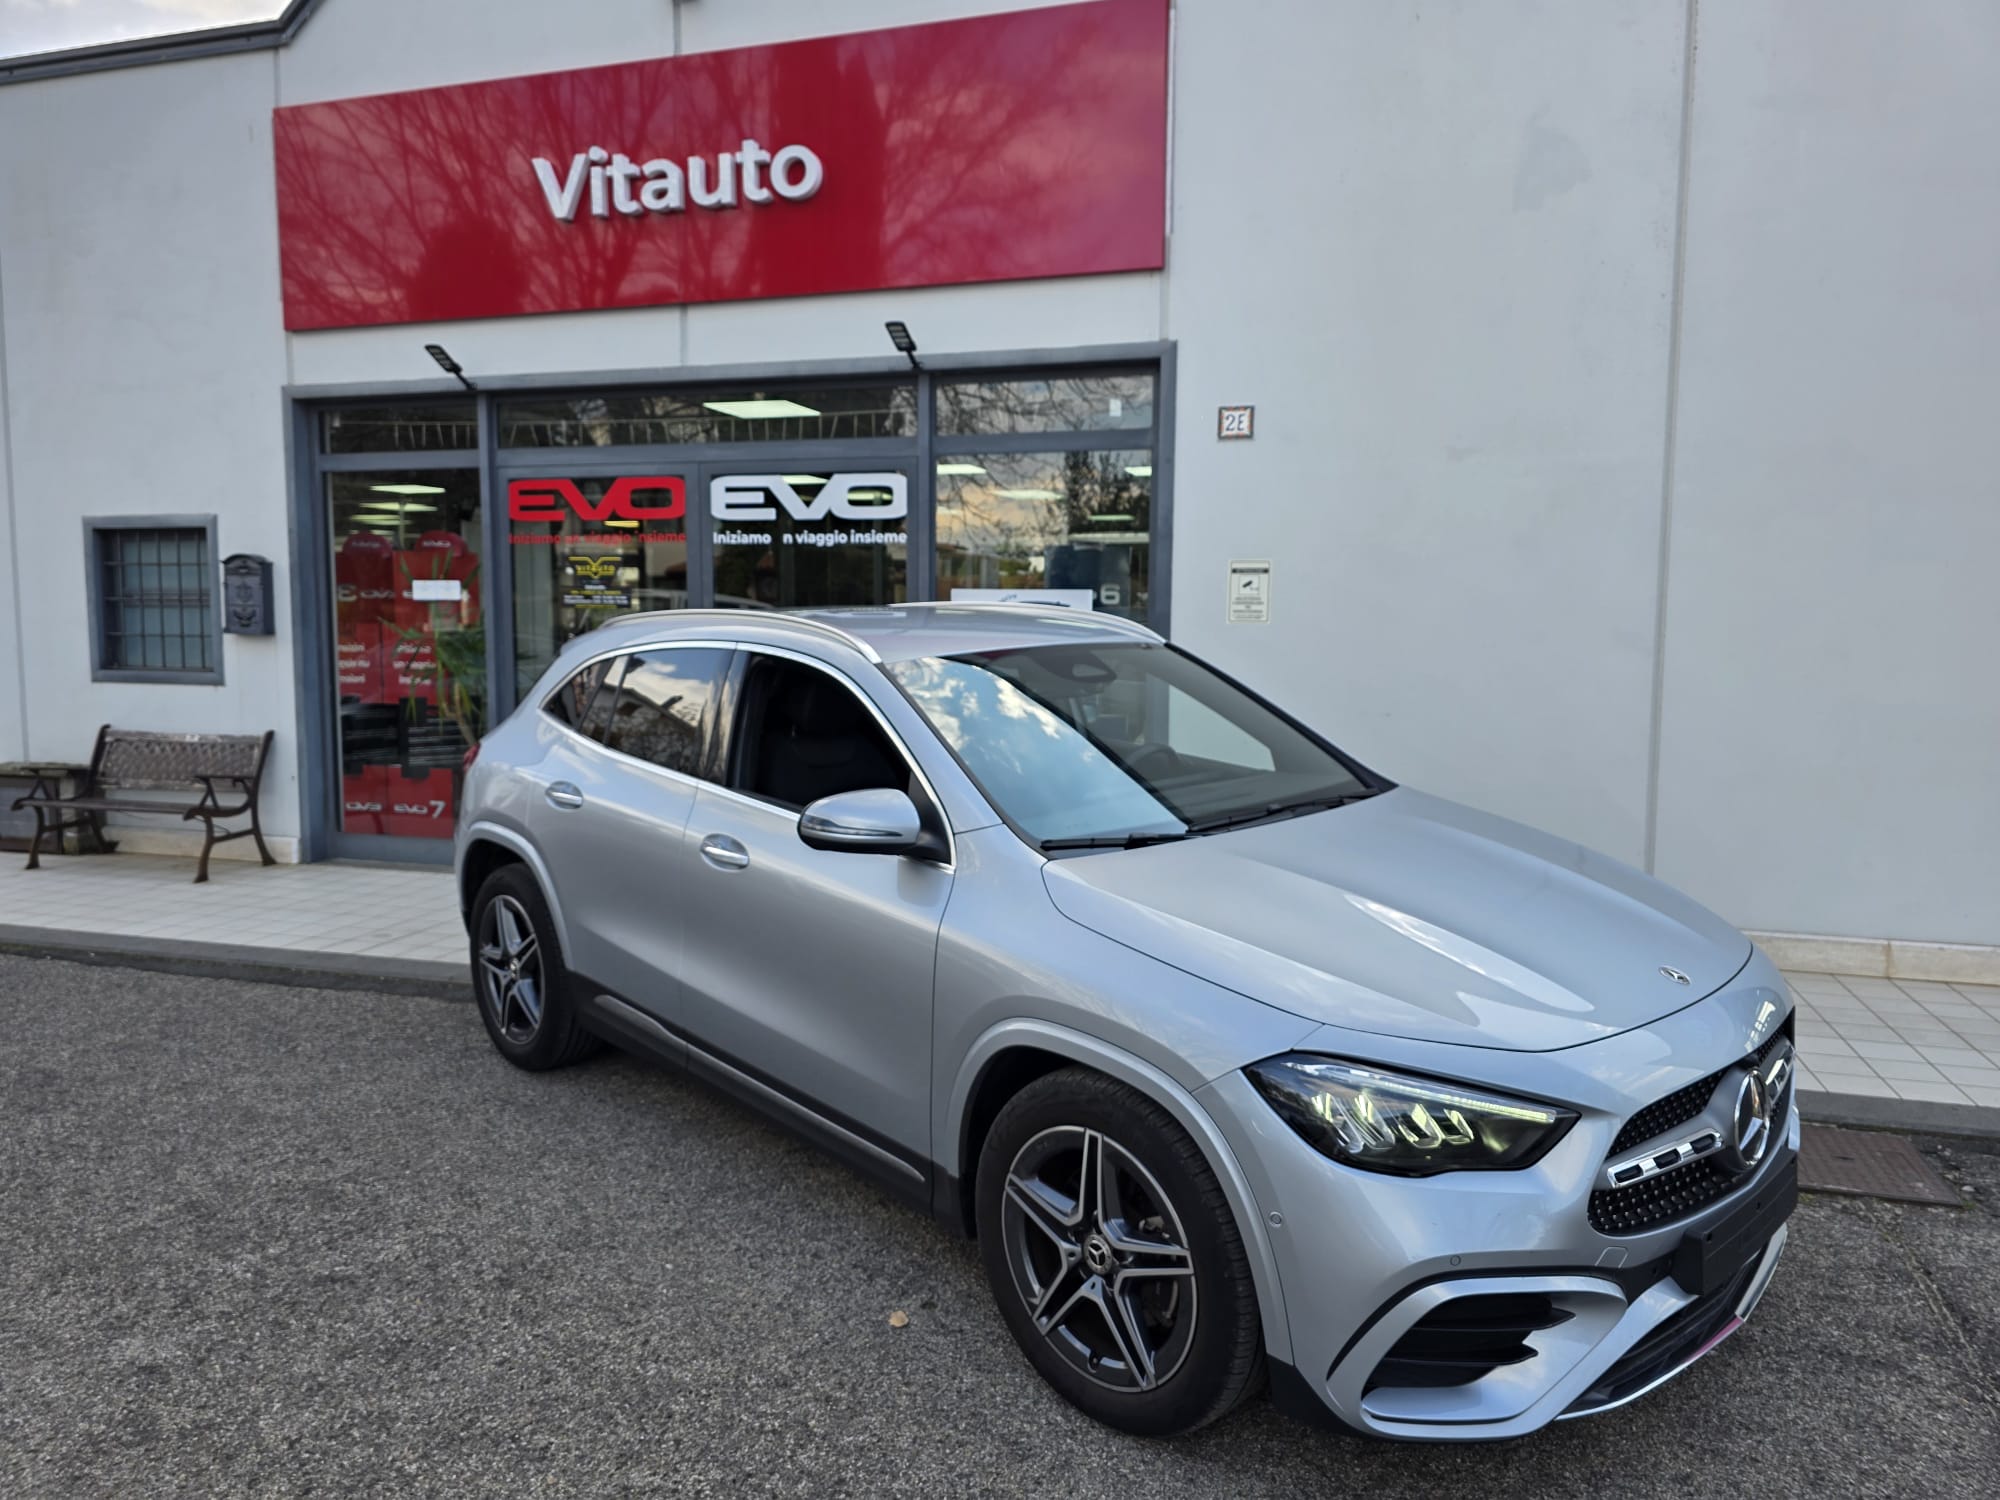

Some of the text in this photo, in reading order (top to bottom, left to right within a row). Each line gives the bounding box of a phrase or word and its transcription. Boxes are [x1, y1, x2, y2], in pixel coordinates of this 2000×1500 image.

[531, 138, 823, 221] Vitauto
[1225, 413, 1246, 431] 2E
[508, 476, 686, 521] EVO
[710, 472, 908, 521] EVO
[585, 531, 631, 545] viaggio
[713, 531, 772, 545] Iniziamo
[796, 530, 848, 547] viaggio
[850, 529, 908, 544] insieme
